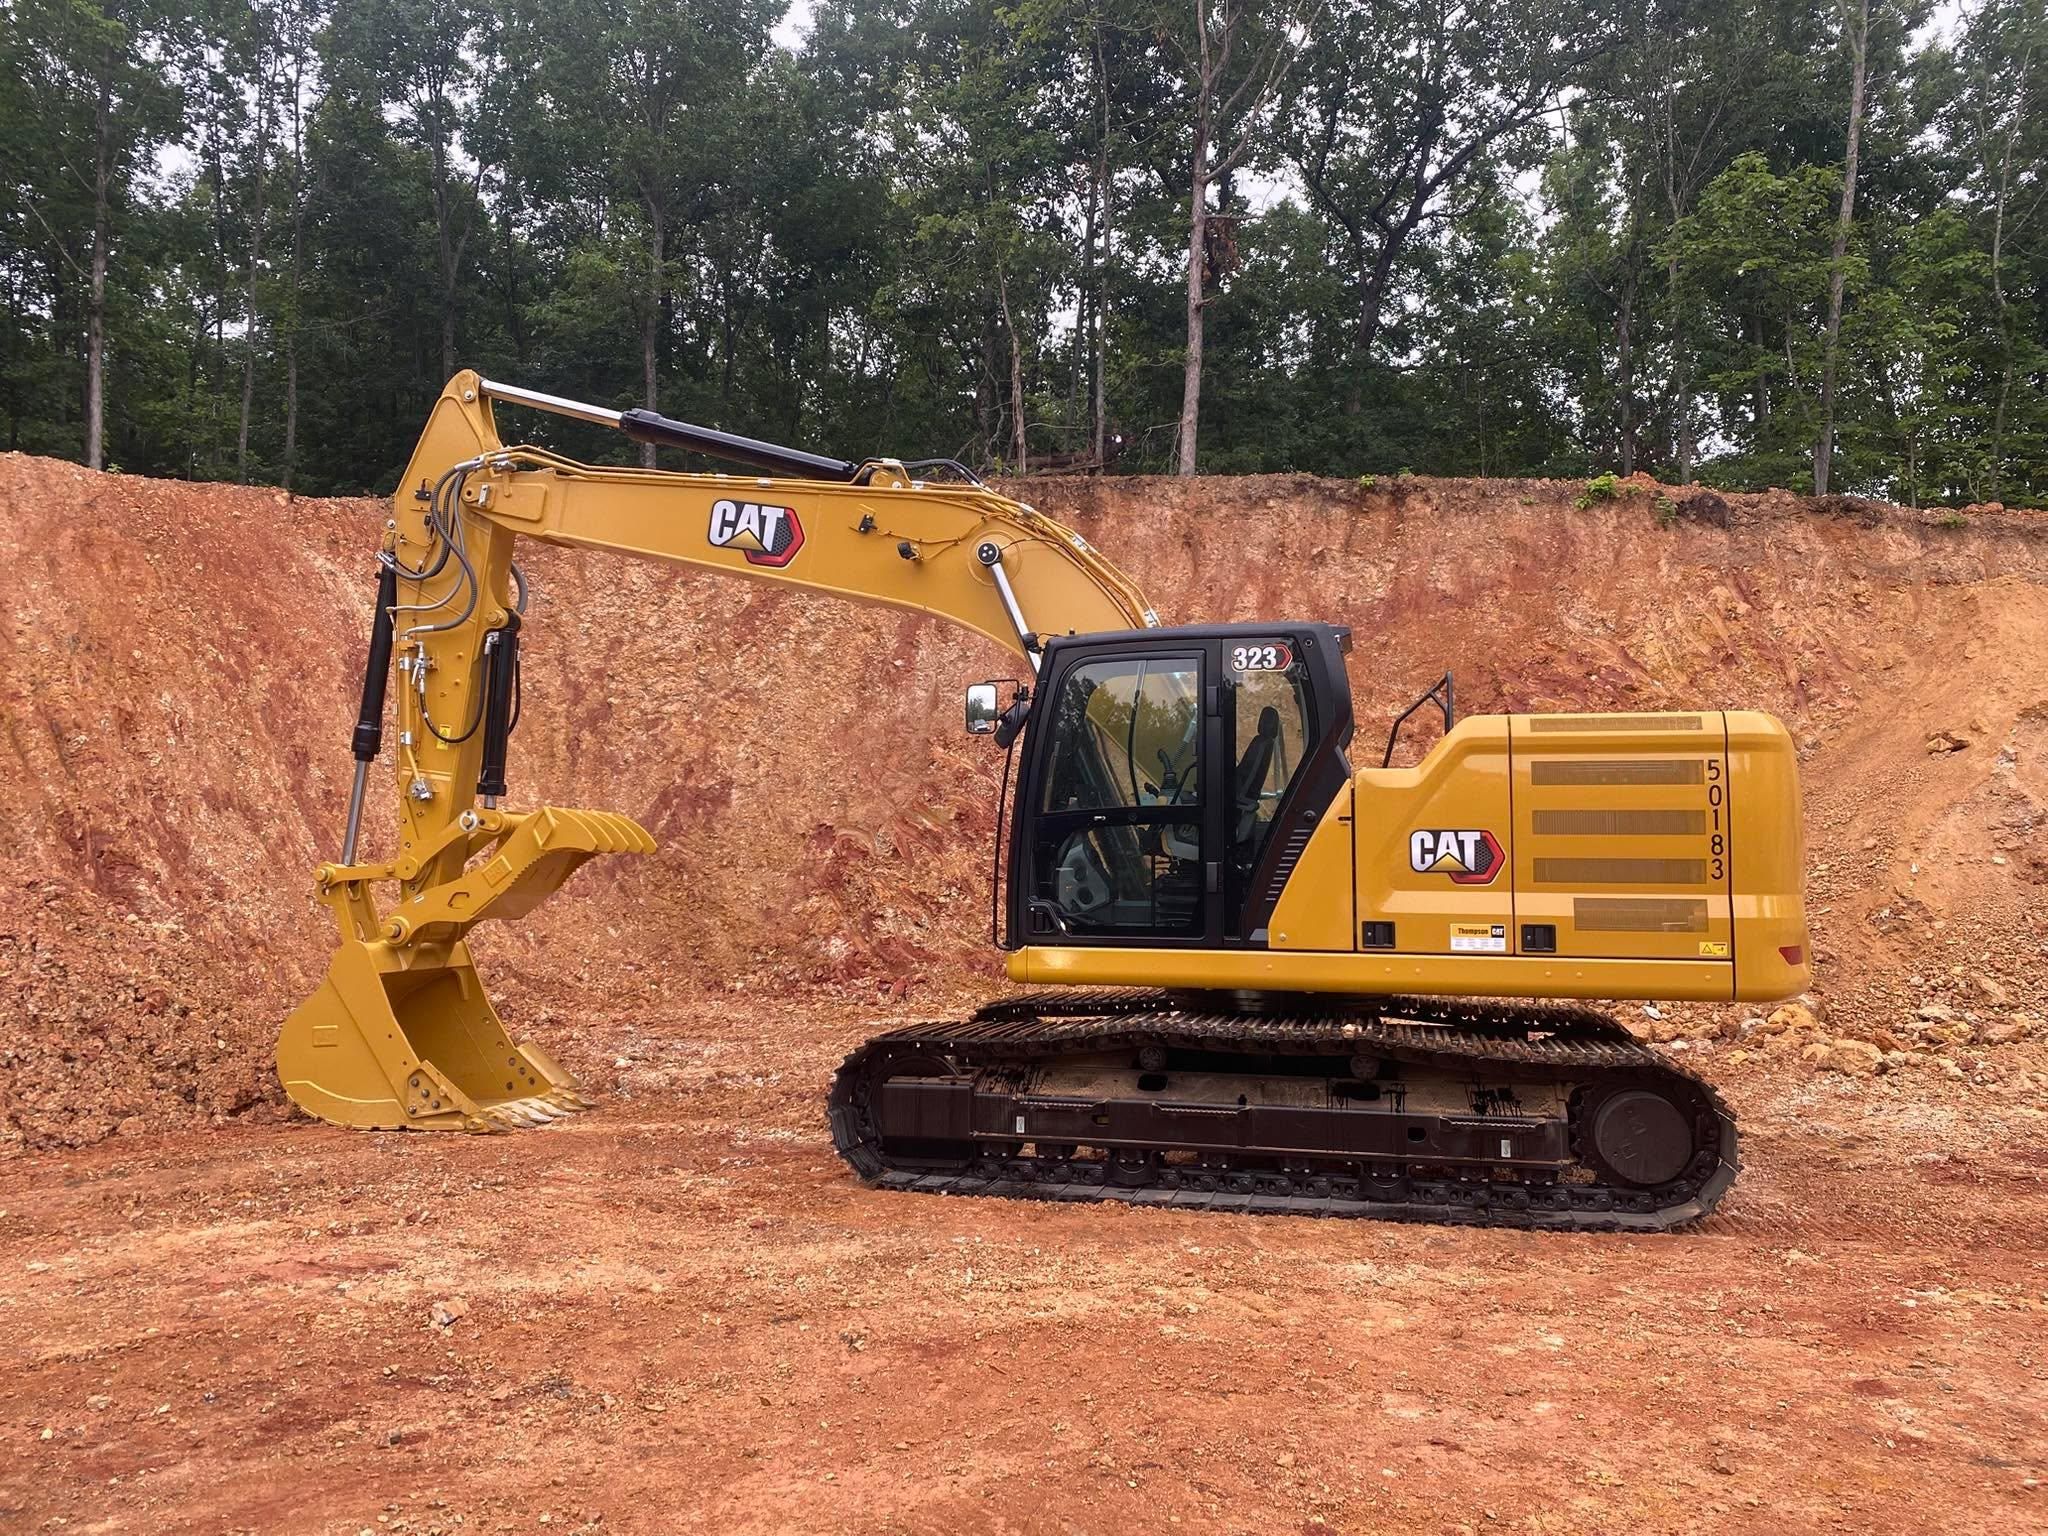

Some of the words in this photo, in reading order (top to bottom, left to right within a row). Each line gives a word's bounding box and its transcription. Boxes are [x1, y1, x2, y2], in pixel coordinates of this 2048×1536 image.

[709, 500, 785, 552] CAT
[1233, 646, 1277, 670] 323
[1707, 759, 1724, 880] 50183
[1410, 830, 1481, 871] CAT
[1491, 928, 1504, 936] CAT
